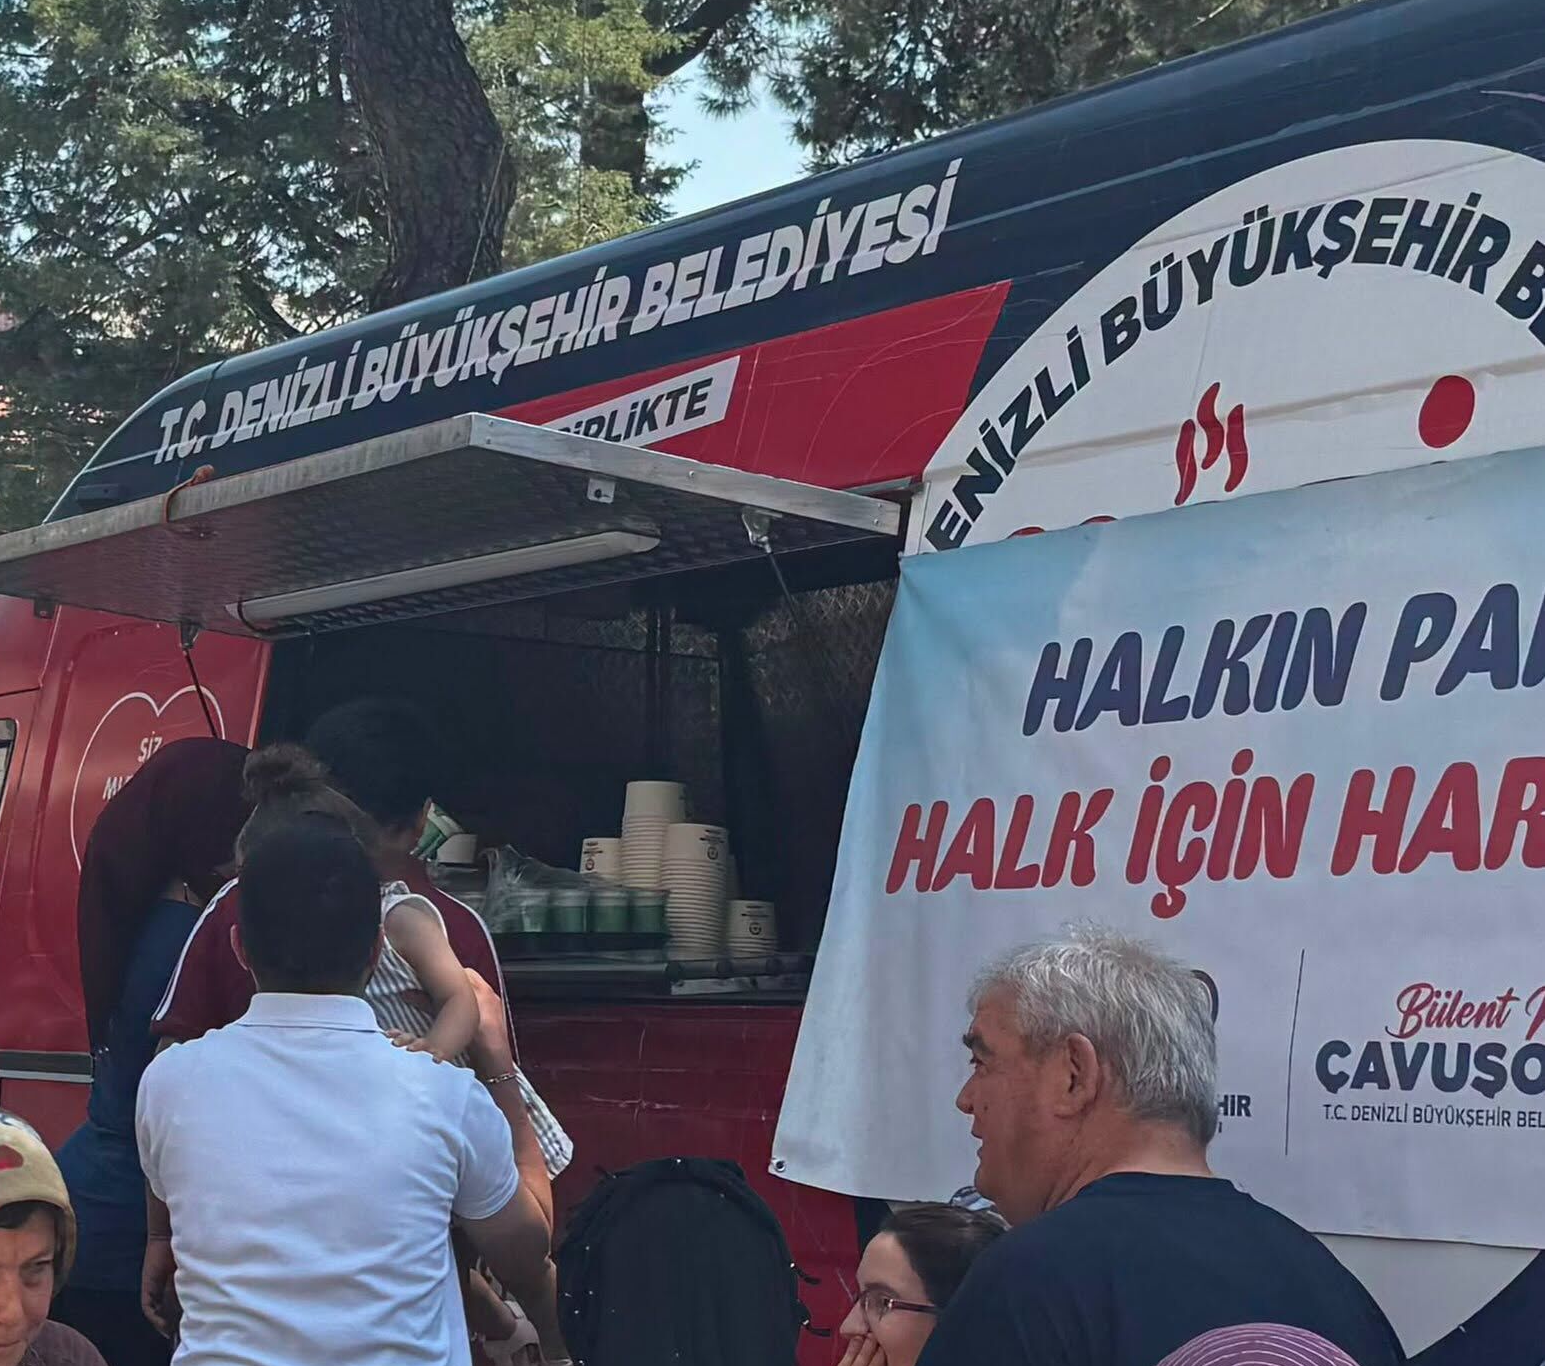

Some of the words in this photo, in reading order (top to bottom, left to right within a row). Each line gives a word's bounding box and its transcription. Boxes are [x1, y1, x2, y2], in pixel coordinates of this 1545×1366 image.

[154, 399, 207, 464] T.C.
[210, 340, 362, 450] DENİZLİ
[350, 265, 630, 411] BÜYÜKŞEHİR
[628, 157, 963, 335] BELEDİYESİ
[1099, 191, 1512, 366] BÜYÜKŞEHİR
[557, 377, 714, 443] RLİKTE
[1022, 601, 1368, 737] HALKIN
[885, 787, 1115, 895] HALK
[1125, 748, 1315, 919] İÇİN
[1385, 982, 1521, 1040] Bülent
[1322, 1103, 1347, 1122] T.C.
[1350, 1101, 1409, 1124] DENİZLİ
[1412, 1103, 1512, 1130] BÜYÜKŞEHİR
